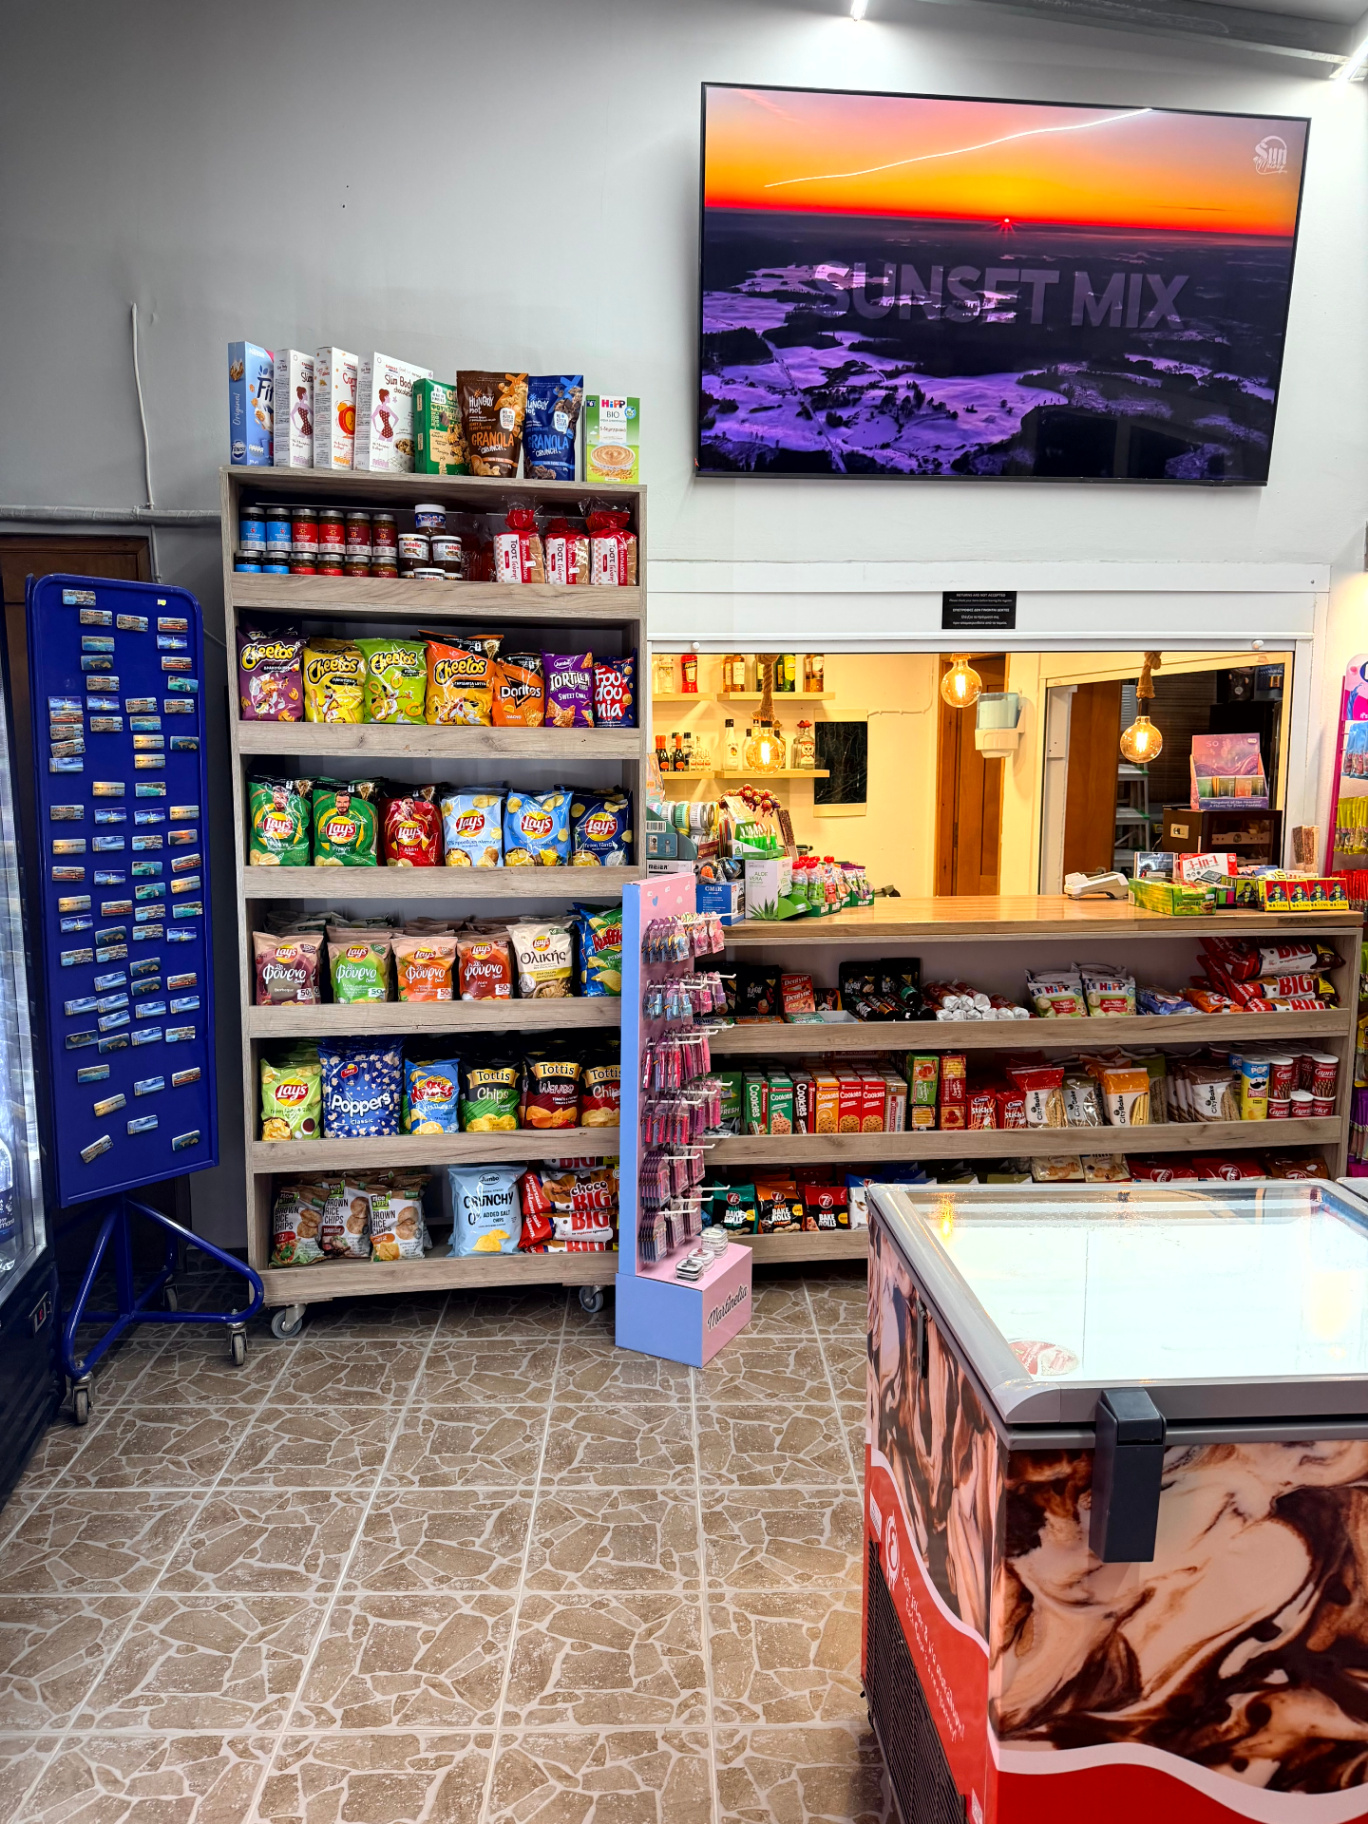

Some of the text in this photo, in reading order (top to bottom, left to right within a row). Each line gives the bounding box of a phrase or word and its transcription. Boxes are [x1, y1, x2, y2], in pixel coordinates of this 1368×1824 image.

[813, 260, 1190, 330] SUNSET MIX
[384, 374, 398, 386] Slim
[232, 392, 244, 426] Original
[606, 411, 620, 419] BIO
[471, 432, 515, 447] GRANOLA
[528, 433, 569, 450] GRANOLA
[241, 643, 295, 671] Cheetos
[369, 650, 416, 674] Cheetos
[308, 658, 358, 684] Cheetos
[435, 656, 487, 685] Cheetos
[550, 672, 591, 692] TORTILLA
[595, 669, 621, 687] Fou
[501, 686, 541, 699] Doritos
[558, 692, 574, 700] SWEET
[595, 686, 622, 701] dou
[597, 702, 622, 719] nia
[265, 820, 292, 834] Lay's
[459, 816, 482, 831] Lay's
[525, 818, 551, 832] Lay's
[589, 820, 616, 834] Lay's
[328, 824, 355, 838] Lay's
[399, 827, 422, 840] Lay's
[1188, 855, 1218, 869] 3-in-1
[472, 944, 491, 955] Lay's
[534, 939, 549, 947] Lay's
[276, 949, 297, 958] Lay's
[347, 949, 367, 958] Lay's
[521, 950, 566, 967] Ολικής
[1279, 975, 1313, 996] BIG
[786, 990, 811, 1002] Dentyne
[477, 1070, 511, 1083] Tottis
[540, 1064, 575, 1076] Tottis
[277, 1084, 308, 1100] Lay's
[477, 1088, 509, 1103] Chips
[770, 1093, 793, 1101] Cookies
[817, 1092, 839, 1100] Cookies
[840, 1091, 862, 1099] Cookies
[863, 1091, 885, 1099] Cookies
[332, 1092, 391, 1117] Poppers
[749, 1084, 760, 1117] Cookies
[796, 1083, 807, 1117] Cookies
[1209, 1085, 1218, 1114] CityBake
[1119, 1095, 1127, 1124] CityBake
[571, 1181, 607, 1196] choco
[326, 1199, 349, 1207] BROWN
[464, 1192, 514, 1209] CRUNCHY
[573, 1190, 612, 1211] BIG
[275, 1206, 299, 1215] BROWN
[325, 1207, 339, 1215] RICE
[373, 1211, 396, 1219] BROWN
[772, 1208, 789, 1216] BAKE
[275, 1214, 289, 1222] RICE
[324, 1215, 344, 1224] CHIPS
[373, 1219, 386, 1228] RICE
[571, 1211, 610, 1231] BIG
[772, 1214, 791, 1222] ROLLS
[275, 1222, 294, 1231] CHIPS
